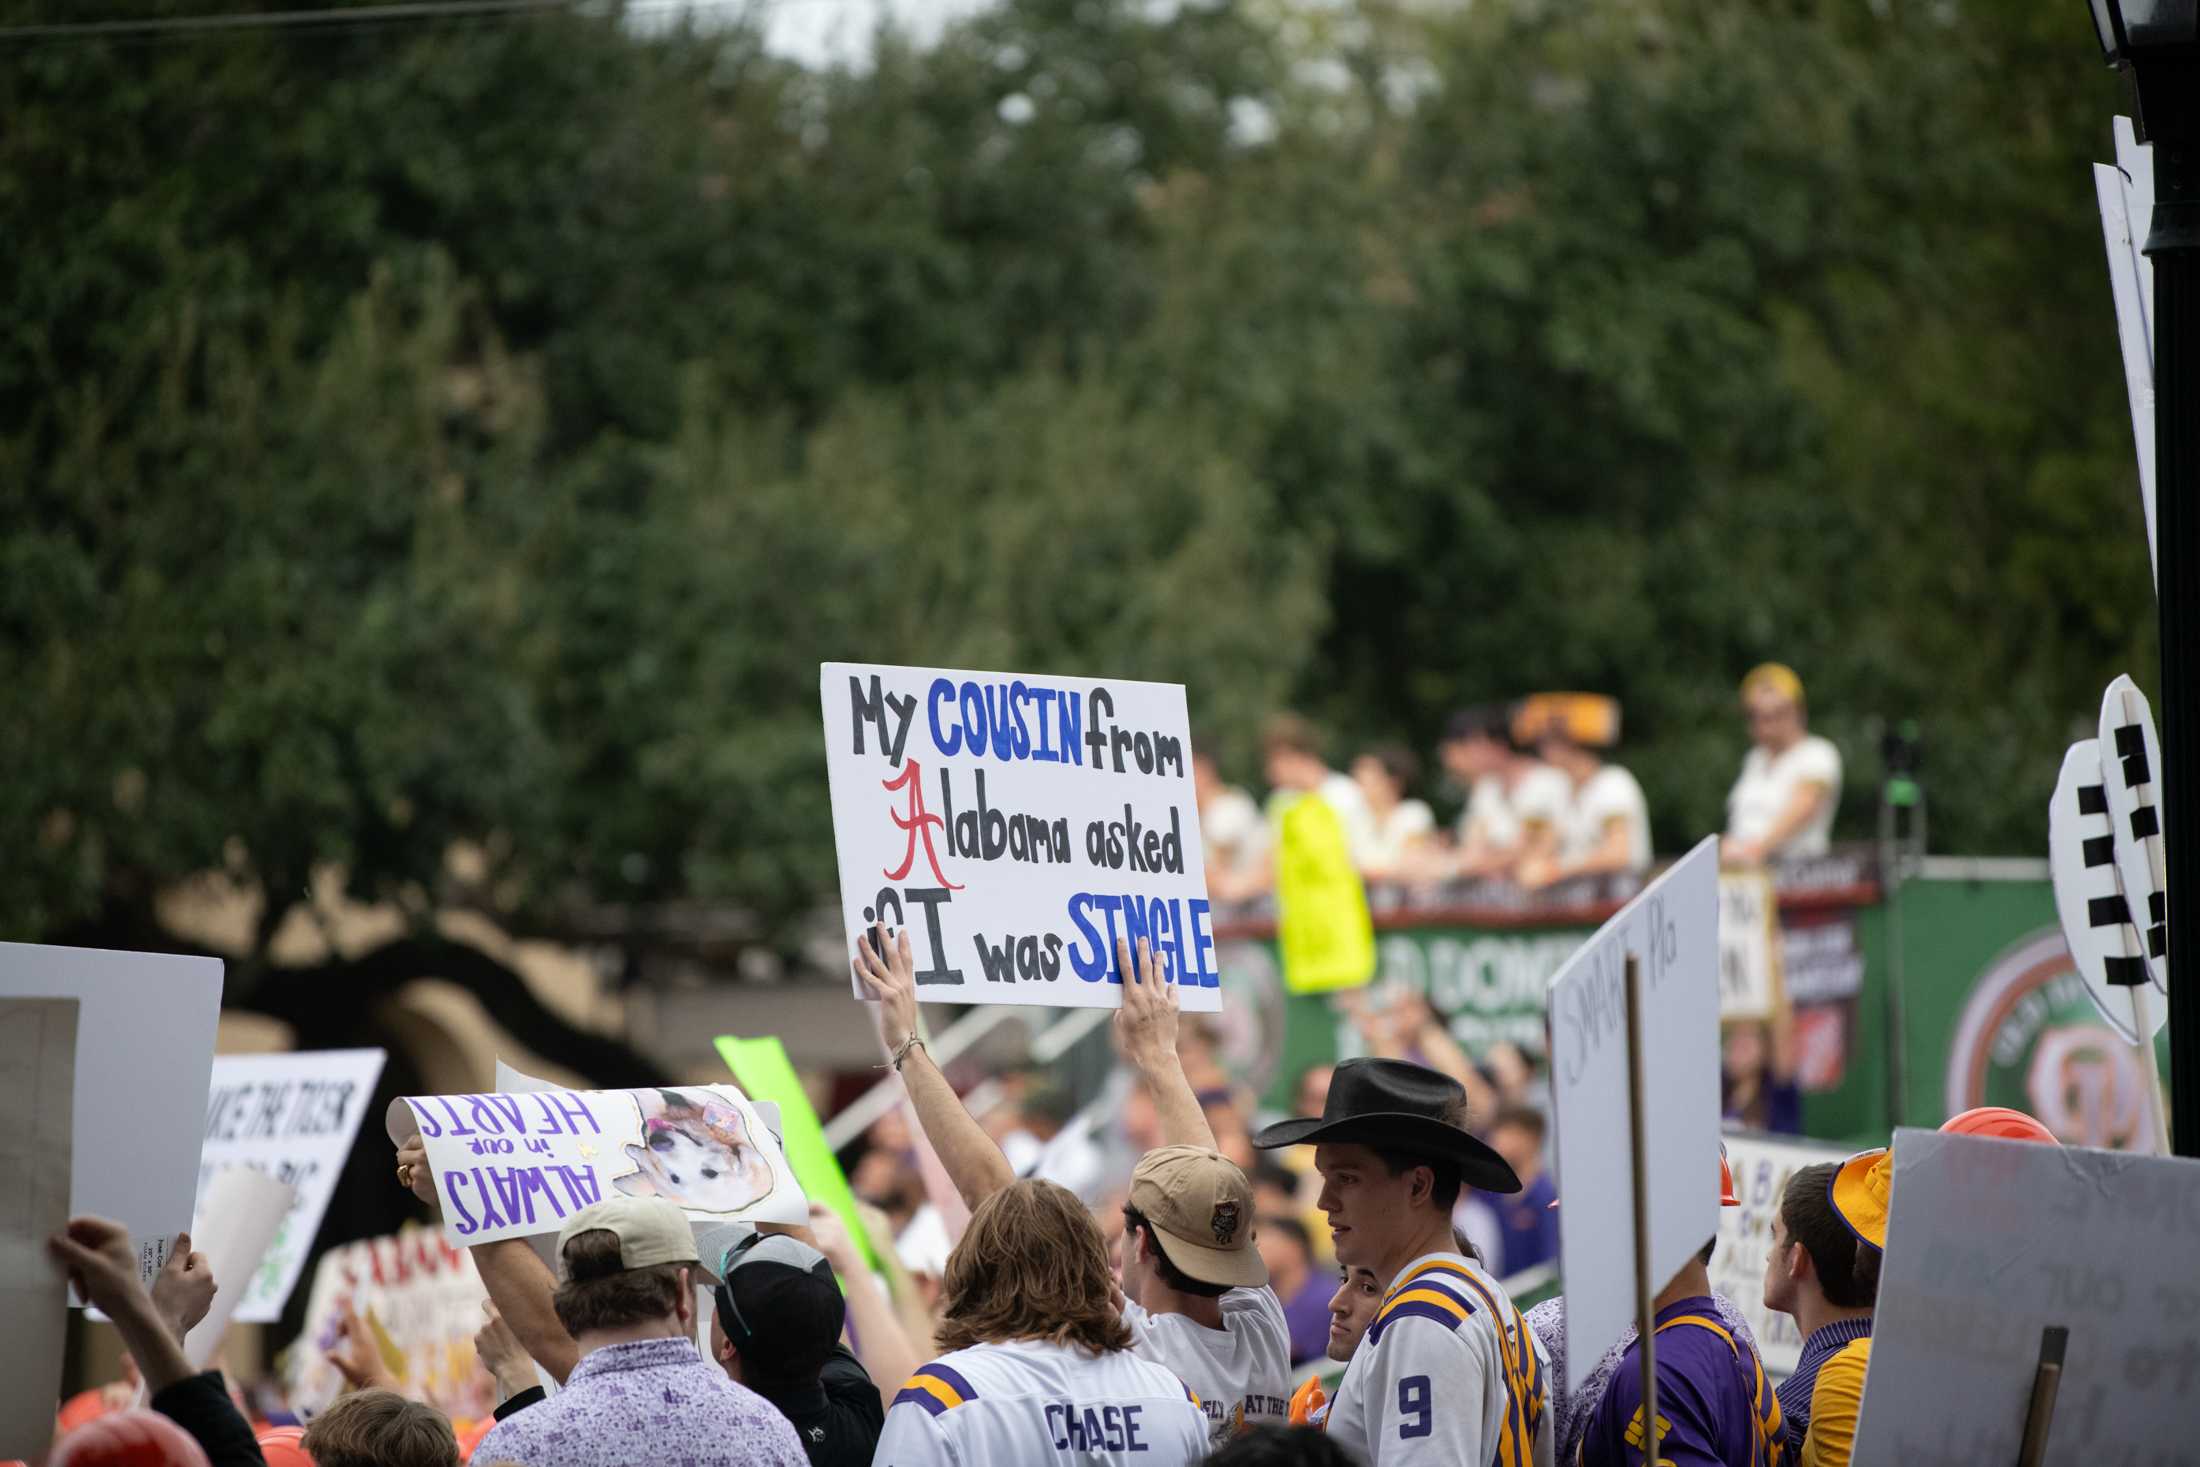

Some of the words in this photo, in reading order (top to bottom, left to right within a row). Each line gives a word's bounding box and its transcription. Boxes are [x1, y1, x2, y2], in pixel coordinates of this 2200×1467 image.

[849, 674, 918, 767] My
[928, 678, 1083, 766] COUSIN
[1085, 687, 1184, 778] from
[882, 758, 1071, 889] Alabama
[1086, 803, 1184, 874] asked
[904, 887, 965, 985] I
[973, 933, 1063, 983] was
[1067, 892, 1219, 988] SINGLE
[524, 1138, 555, 1158] in
[444, 1165, 601, 1234] ALWAYS
[1045, 1404, 1149, 1452] CHASE
[1244, 1394, 1265, 1414] AT
[1267, 1396, 1284, 1416] THE
[1399, 1375, 1432, 1440] 9
